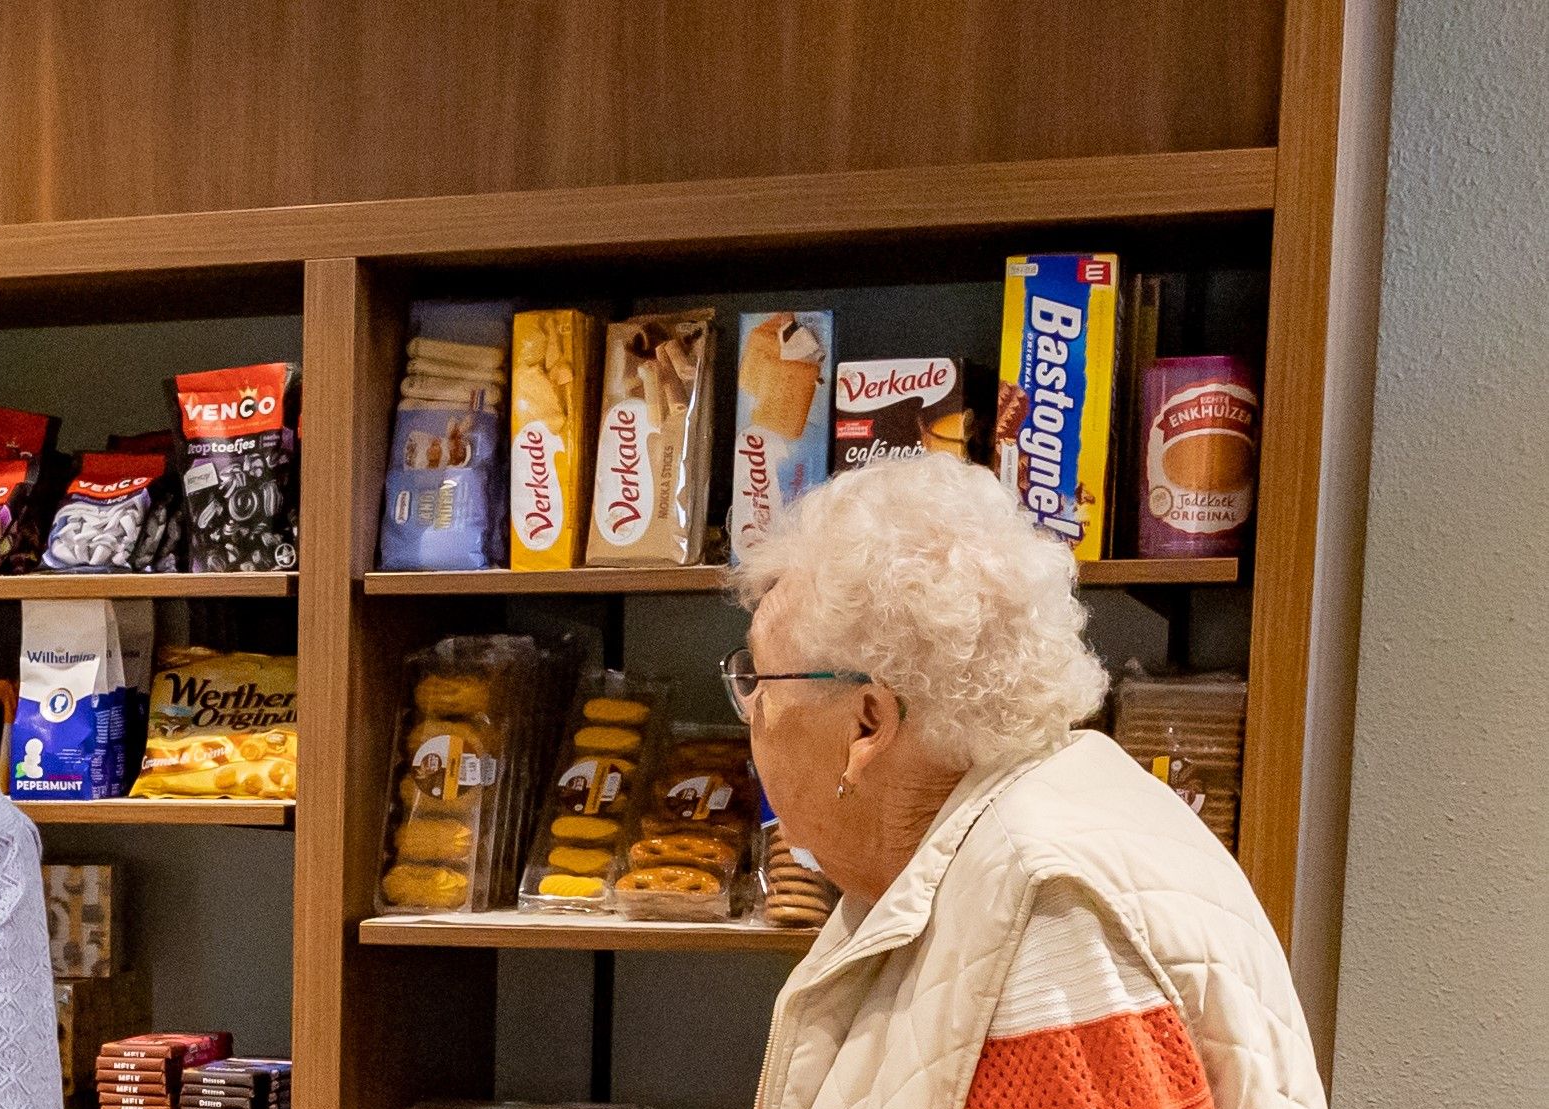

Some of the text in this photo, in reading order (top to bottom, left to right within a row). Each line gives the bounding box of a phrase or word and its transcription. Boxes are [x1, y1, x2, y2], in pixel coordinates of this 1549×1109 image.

[838, 361, 948, 403] Verkade
[184, 395, 276, 421] VENCO
[845, 438, 888, 465] café
[78, 476, 148, 493] VENCO
[608, 408, 642, 535] Verkade
[520, 430, 555, 541] Verkade
[1170, 509, 1237, 522] ORIGINAL
[27, 650, 97, 664] Wilhelmina
[164, 672, 297, 710] Werther
[16, 779, 83, 791] PEPERMUNT
